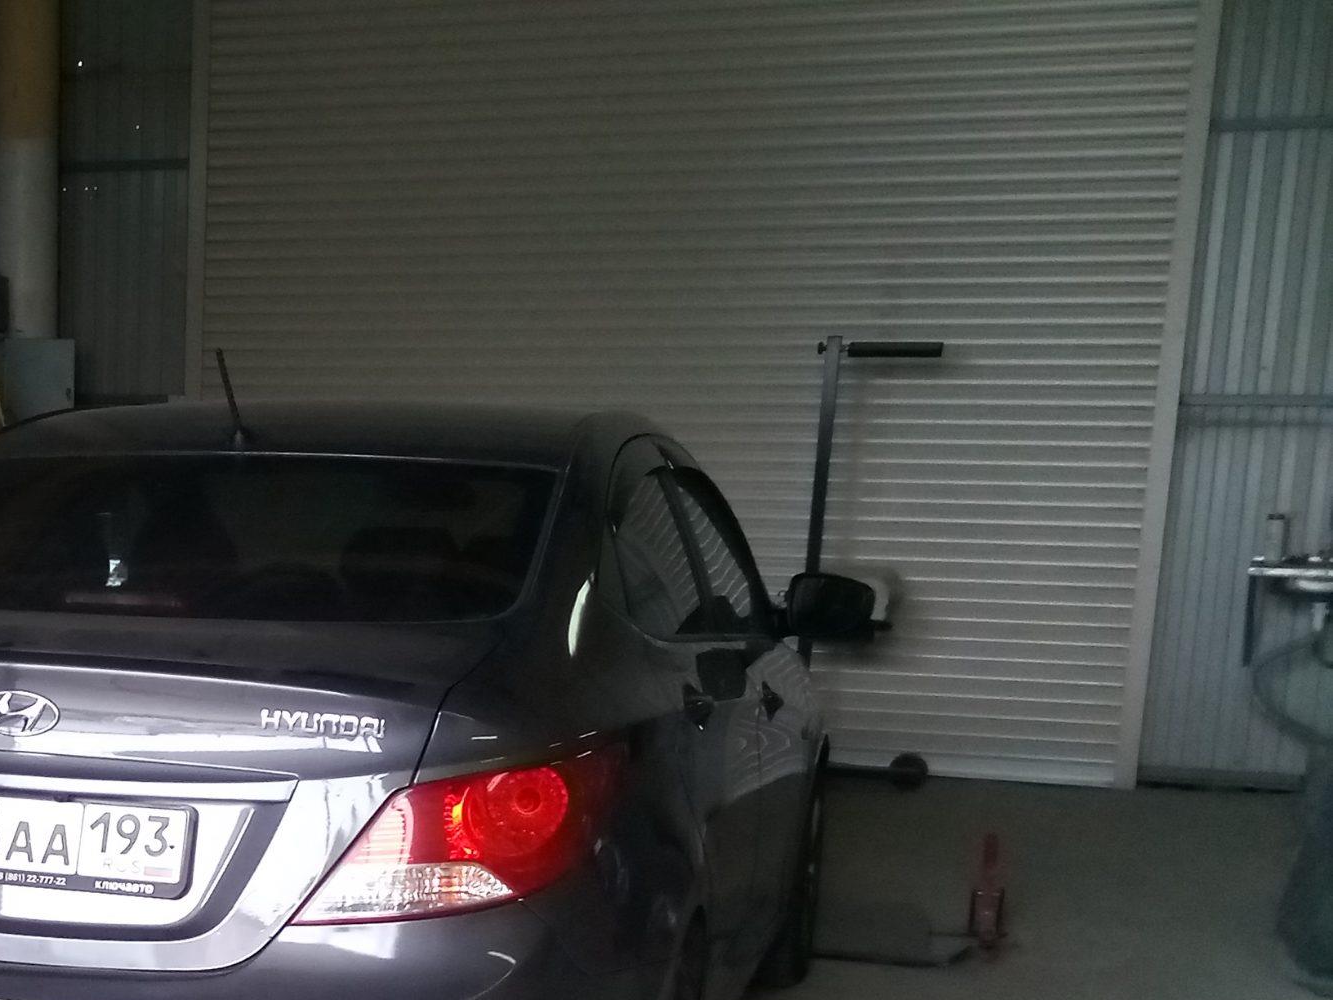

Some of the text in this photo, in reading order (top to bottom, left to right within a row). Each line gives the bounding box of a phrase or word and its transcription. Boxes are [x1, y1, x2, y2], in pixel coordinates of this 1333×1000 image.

[260, 708, 385, 739] HYUNDAI
[89, 811, 171, 858] 193
[102, 858, 141, 875] RUS
[26, 874, 67, 886] 22-777-22
